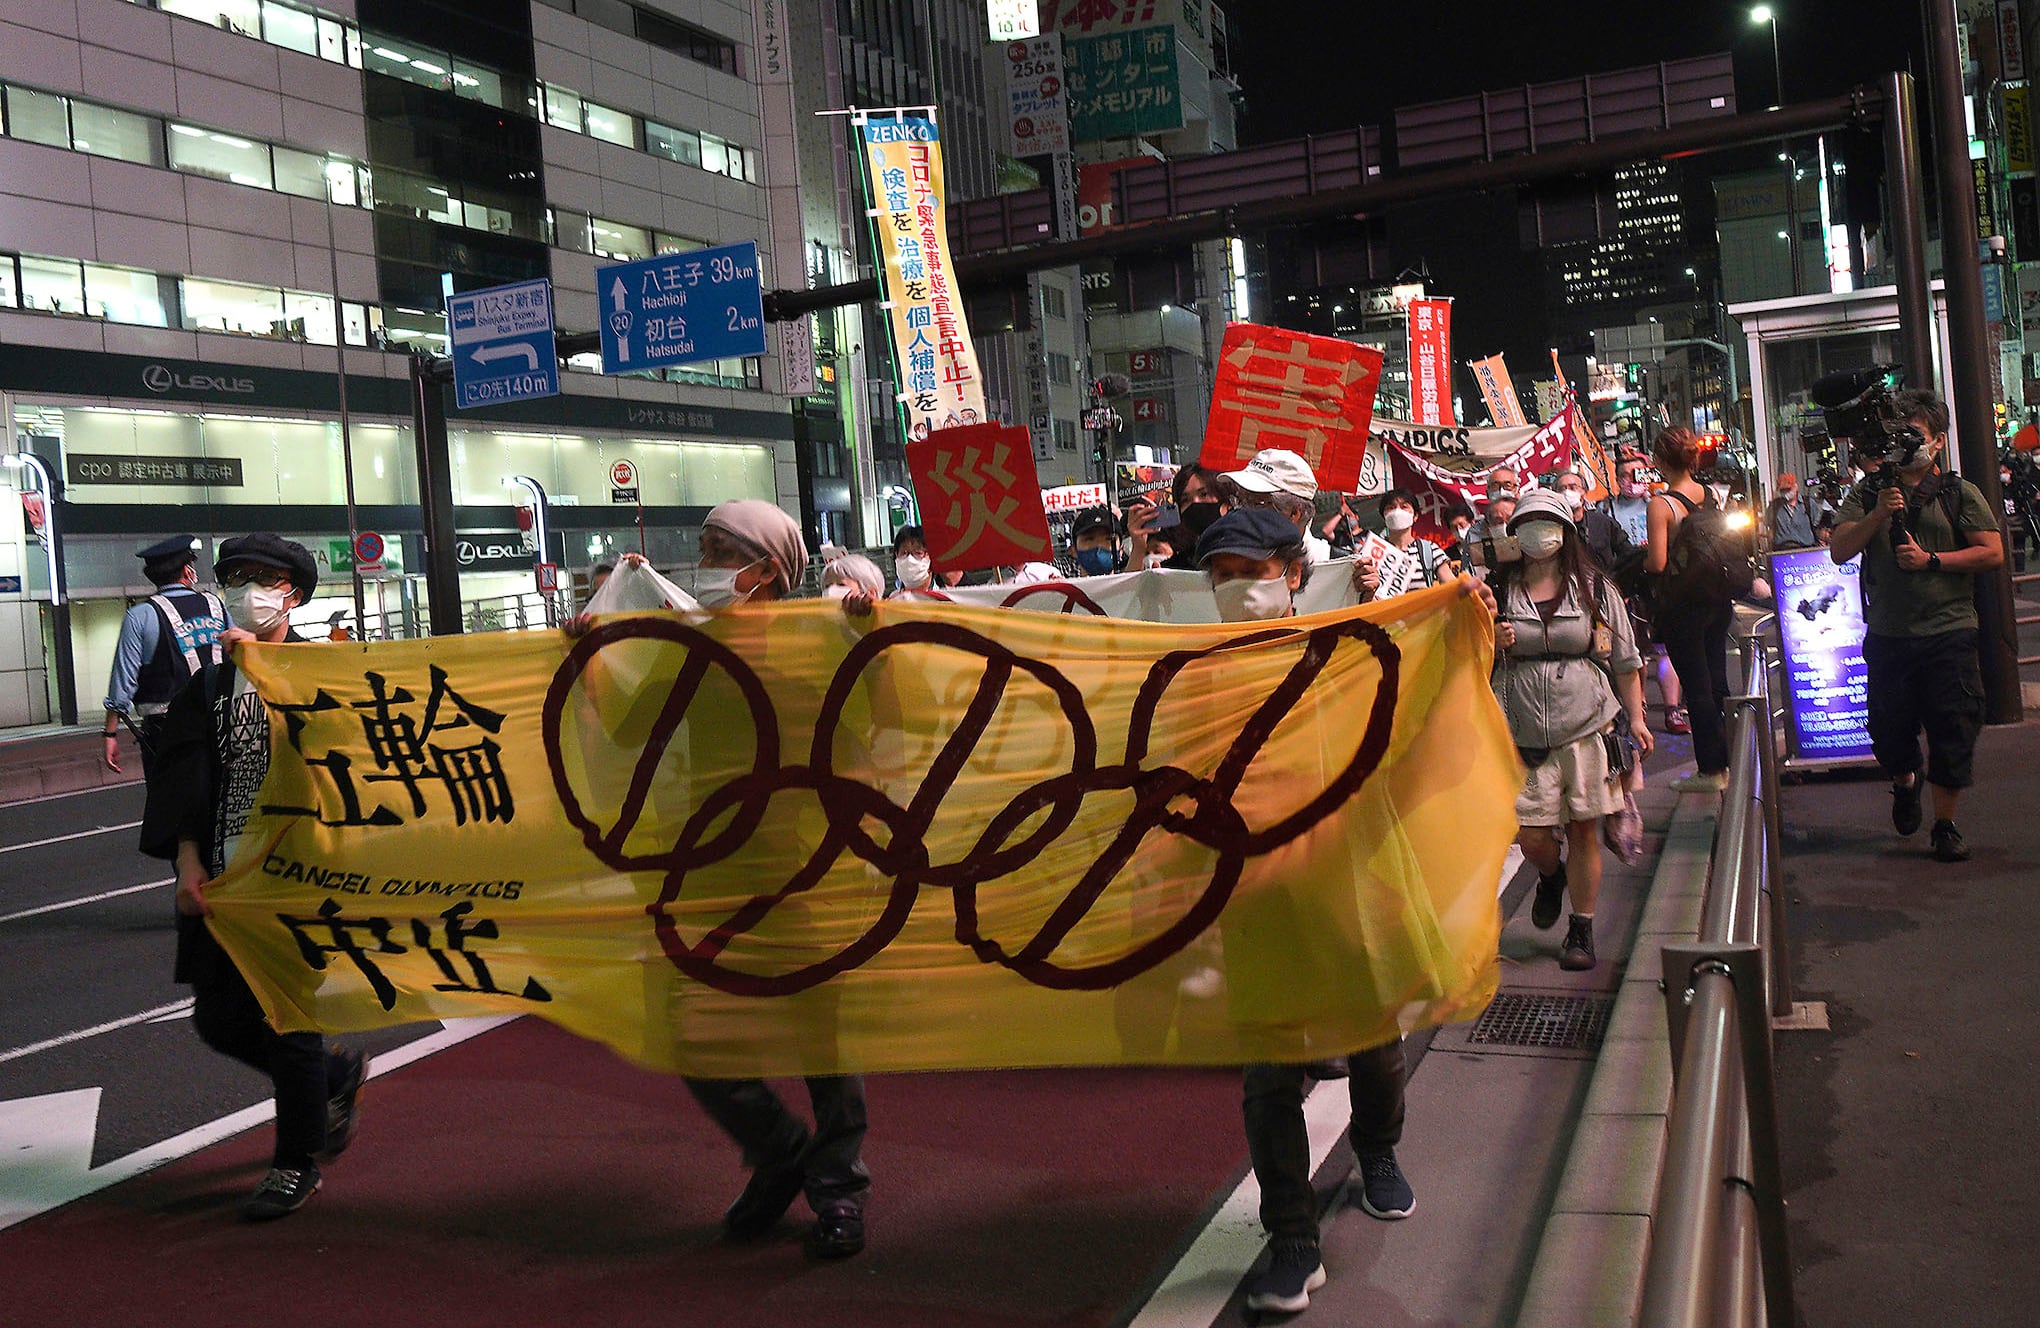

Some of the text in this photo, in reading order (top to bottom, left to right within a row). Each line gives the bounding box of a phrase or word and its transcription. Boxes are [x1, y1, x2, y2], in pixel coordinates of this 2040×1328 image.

[872, 125, 929, 142] ZENKO
[641, 261, 705, 294] 八王子
[882, 167, 939, 412] 検査を 治療を 個人補償を
[478, 289, 544, 314] バスタ新宿
[642, 291, 687, 311] Hachioji
[478, 313, 510, 327] Shinjuku
[497, 317, 547, 334] Bus Terminal
[614, 315, 629, 331] 20
[644, 315, 687, 343] 初台
[645, 339, 695, 359] Hatsudai
[1133, 354, 1147, 370] 5
[175, 373, 255, 393] LEXUS
[628, 407, 665, 424] レクサス
[1137, 402, 1151, 418] 4
[118, 462, 188, 481] 認定中古車
[192, 464, 233, 481] 展示中
[926, 441, 1048, 563] 災
[1045, 487, 1101, 510] 中止だ!
[261, 664, 515, 827] 五輪
[262, 855, 524, 900] CANCEL OLYMPICS
[276, 898, 553, 1012] 中止
